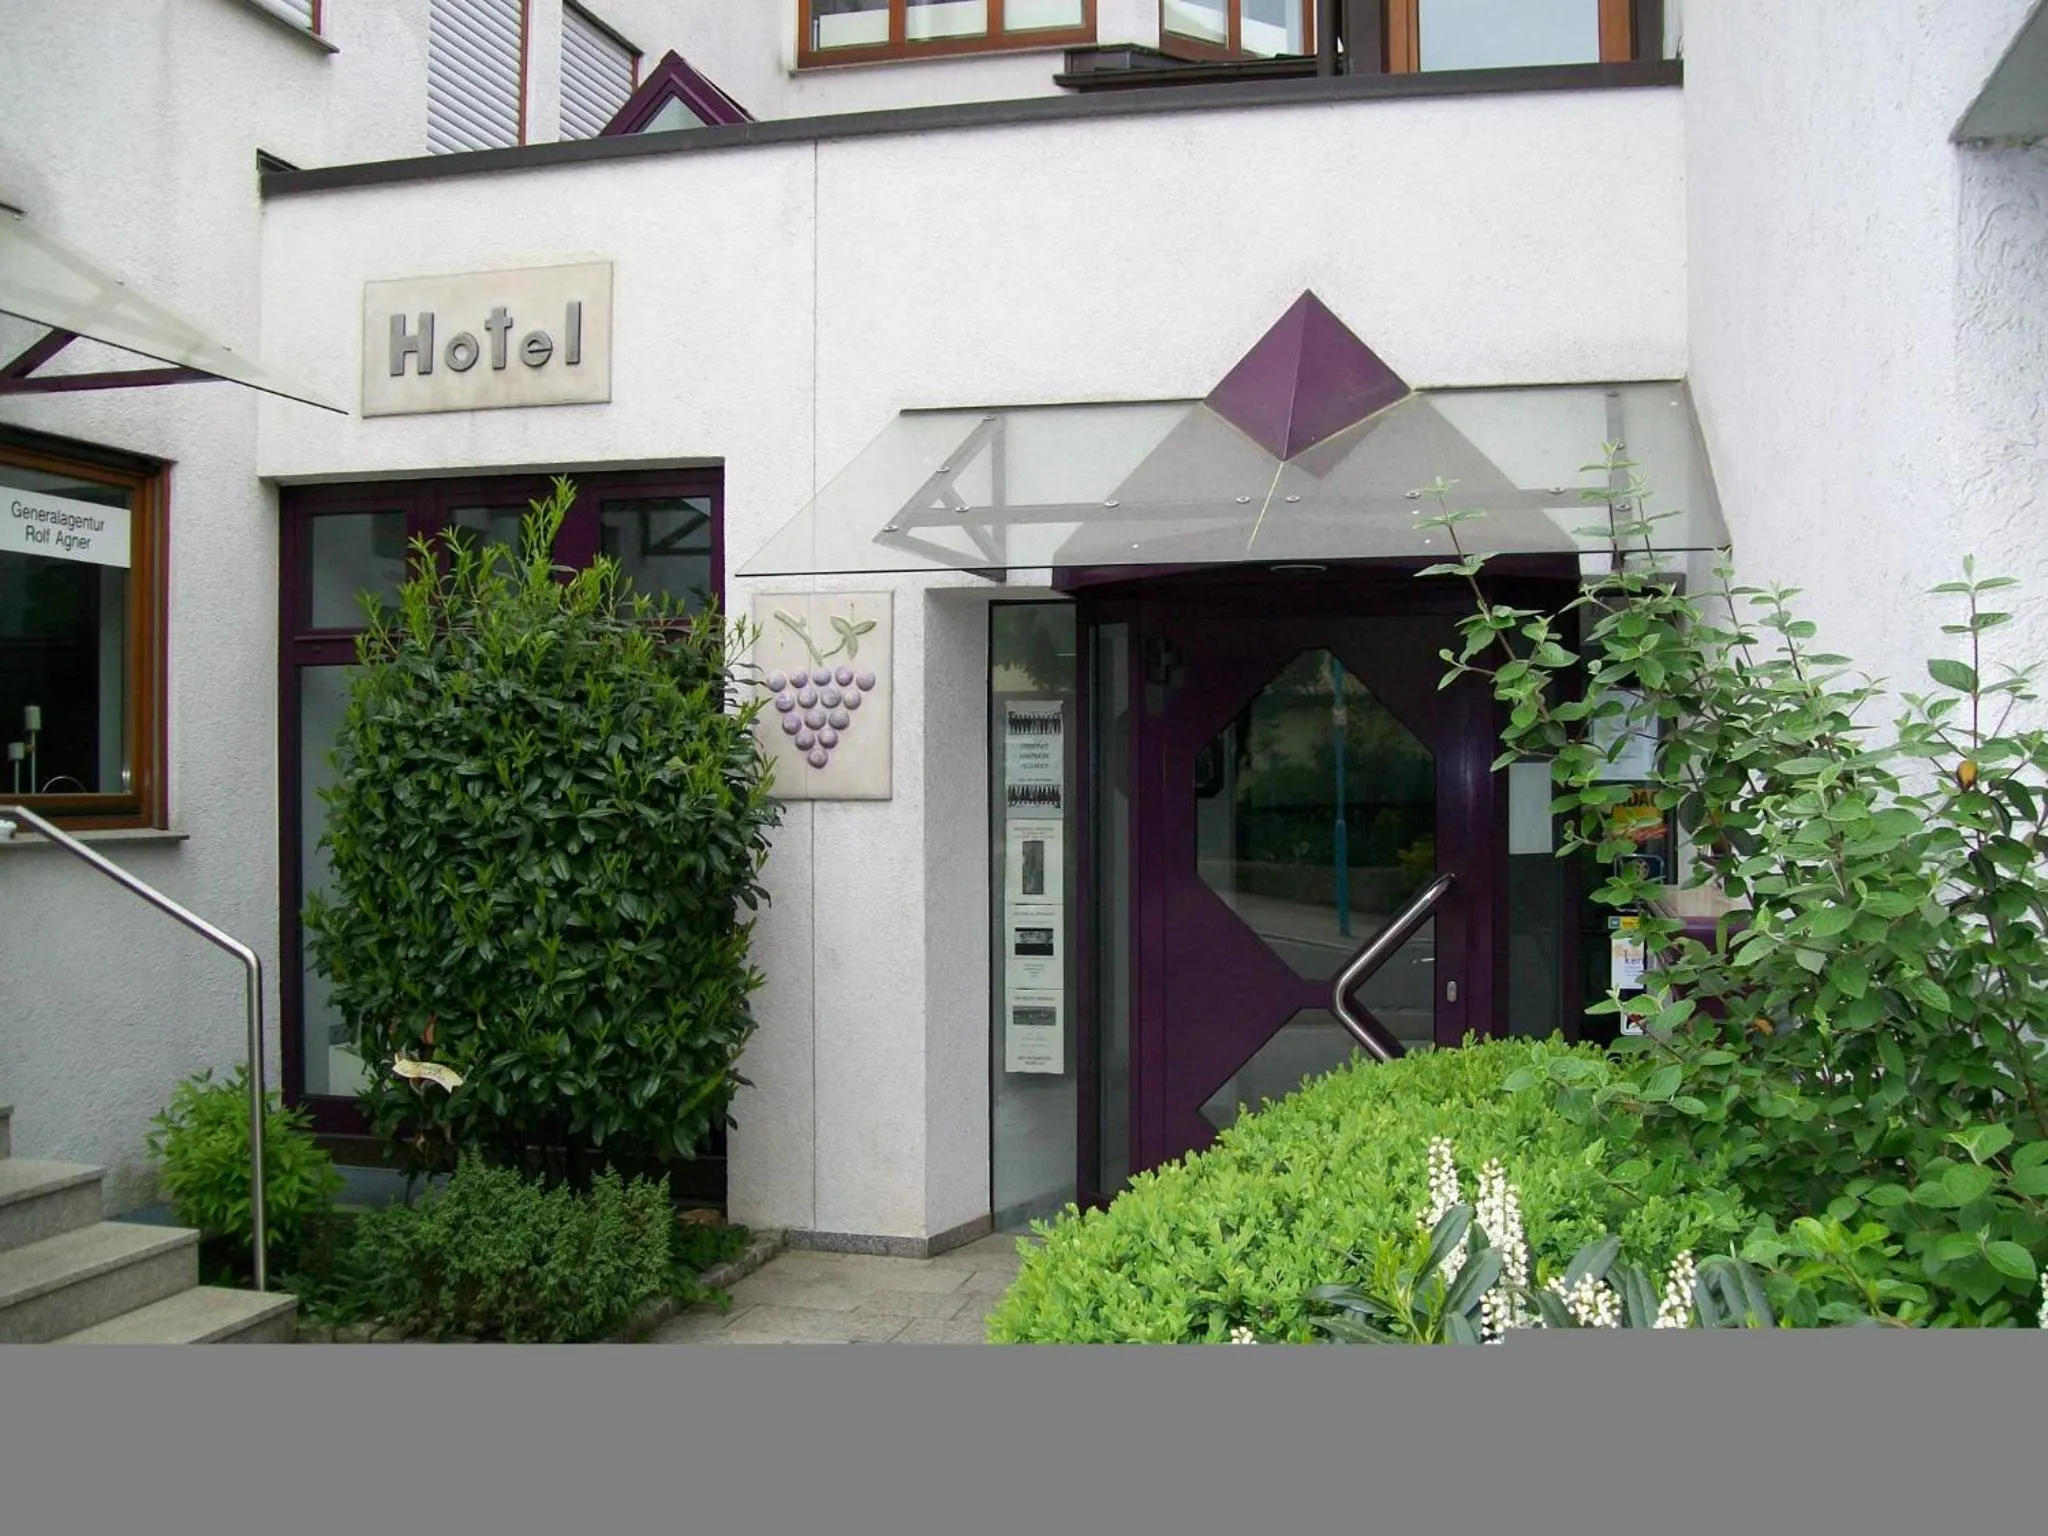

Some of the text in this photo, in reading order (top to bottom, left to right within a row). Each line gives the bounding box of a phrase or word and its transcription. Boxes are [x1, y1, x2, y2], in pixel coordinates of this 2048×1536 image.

[389, 300, 581, 377] Hotel
[11, 500, 105, 532] Generalagentur
[25, 525, 91, 552] Rolf Agner
